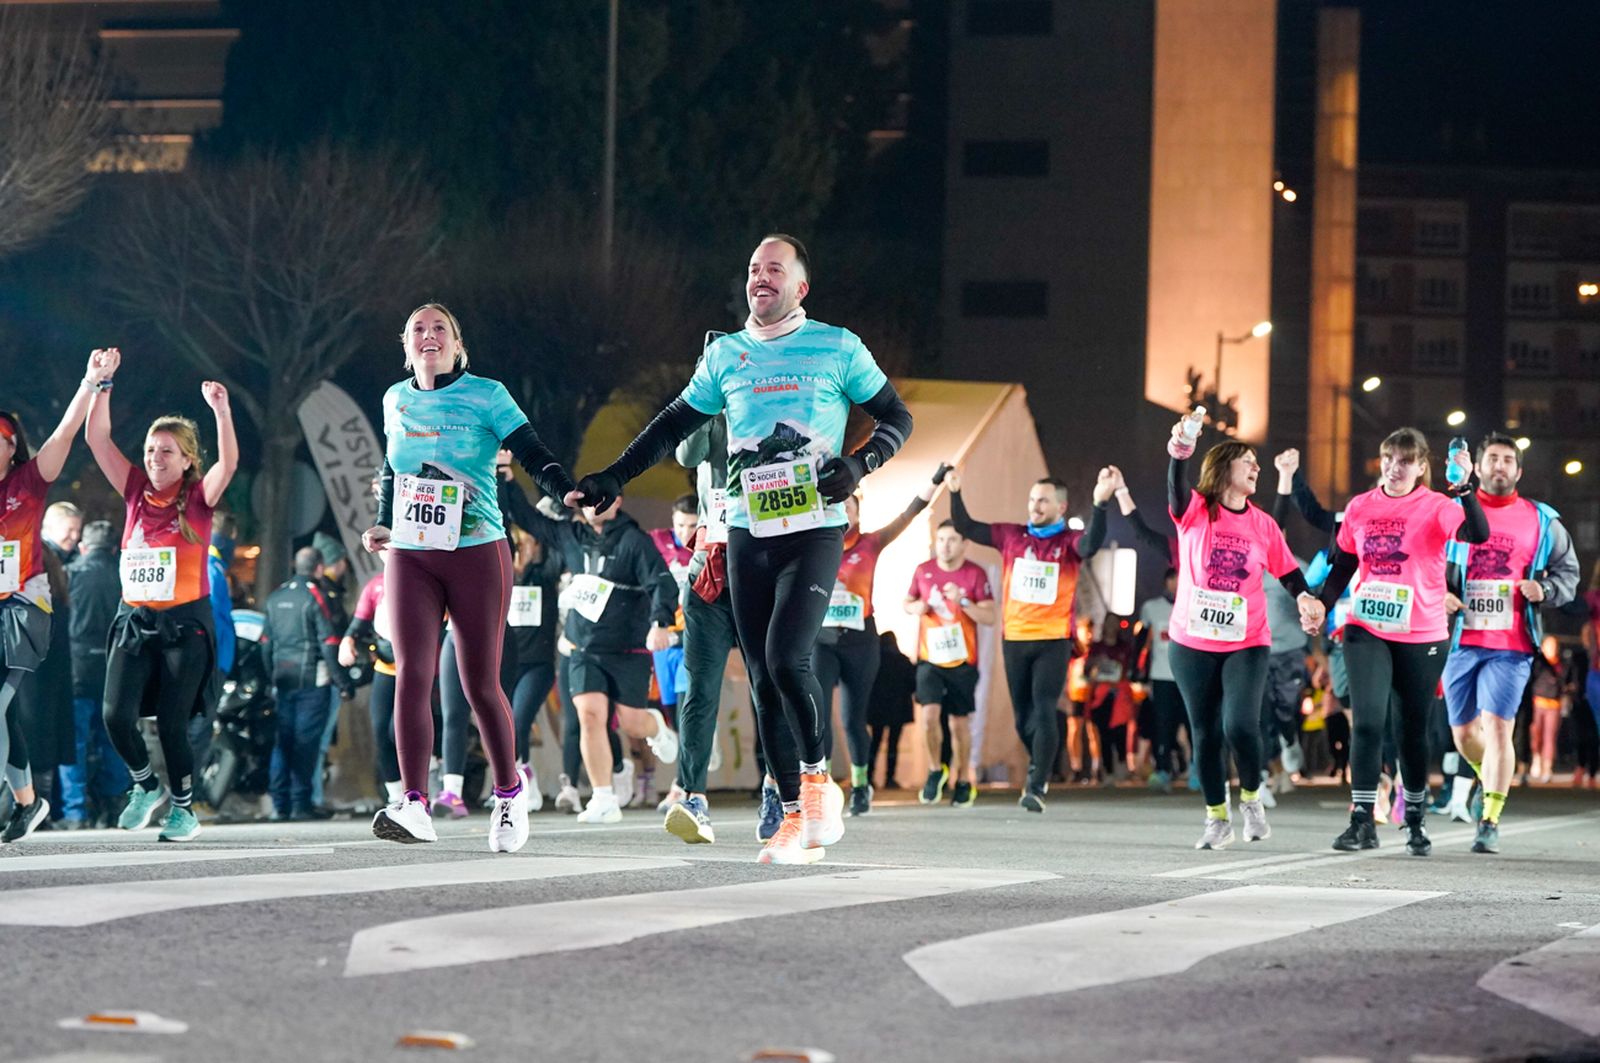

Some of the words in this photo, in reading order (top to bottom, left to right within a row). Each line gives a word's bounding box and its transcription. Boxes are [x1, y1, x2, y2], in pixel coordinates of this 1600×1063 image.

[753, 384, 799, 393] QUESADA
[755, 375, 799, 386] CAZORLA
[340, 415, 381, 517] EMASA
[757, 472, 777, 482] NOCHE
[778, 470, 787, 479] DE
[752, 482, 765, 492] SAN
[757, 485, 807, 513] 2855
[405, 502, 446, 526] 2166
[129, 567, 165, 583] 4838
[1360, 599, 1404, 618] 13907
[1469, 598, 1504, 613] 4690
[1200, 607, 1235, 626] 4702
